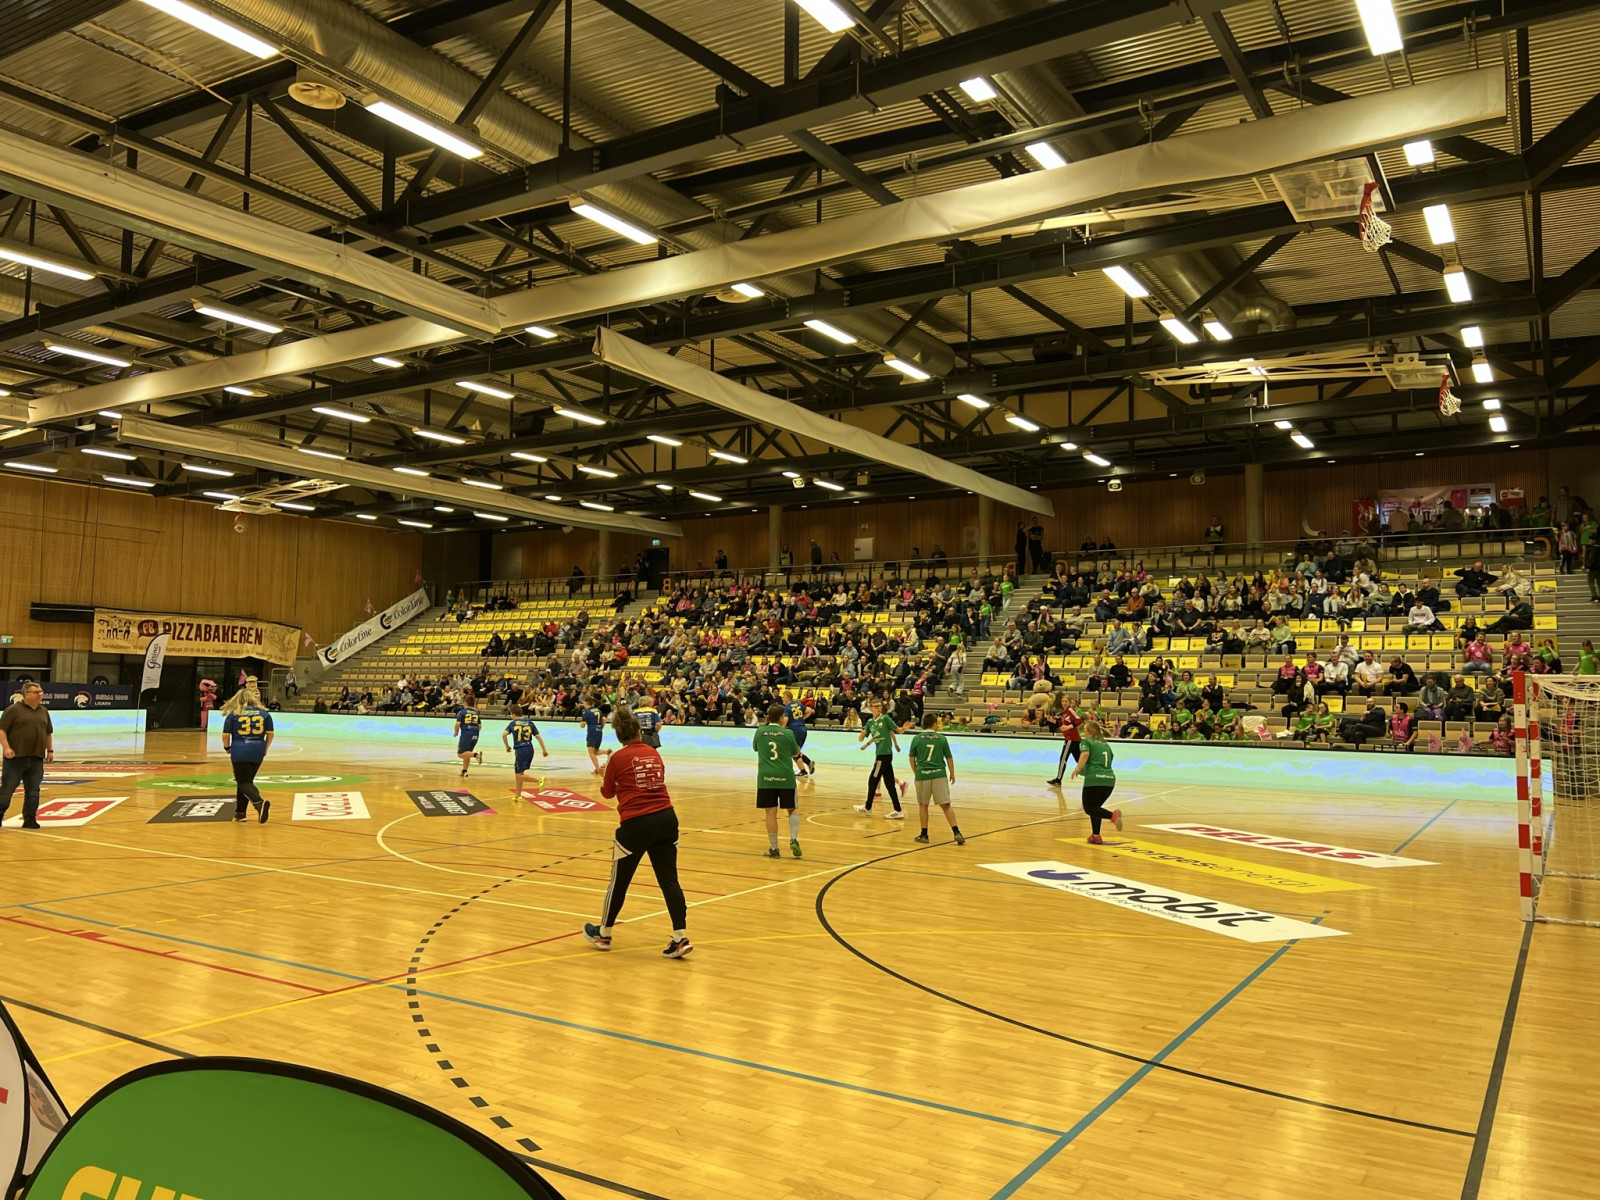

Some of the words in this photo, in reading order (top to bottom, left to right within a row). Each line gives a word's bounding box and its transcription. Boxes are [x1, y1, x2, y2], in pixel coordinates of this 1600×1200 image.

[464, 713, 478, 724] 23
[594, 711, 600, 724] 7
[791, 705, 803, 720] 26
[237, 715, 264, 735] 33
[513, 725, 532, 742] 73
[768, 741, 778, 761] 3
[926, 744, 935, 762] 7
[1102, 751, 1108, 767] 1
[1170, 826, 1380, 860] PELIAS
[1113, 845, 1317, 889] norgesenergi
[1075, 880, 1276, 927] mobit
